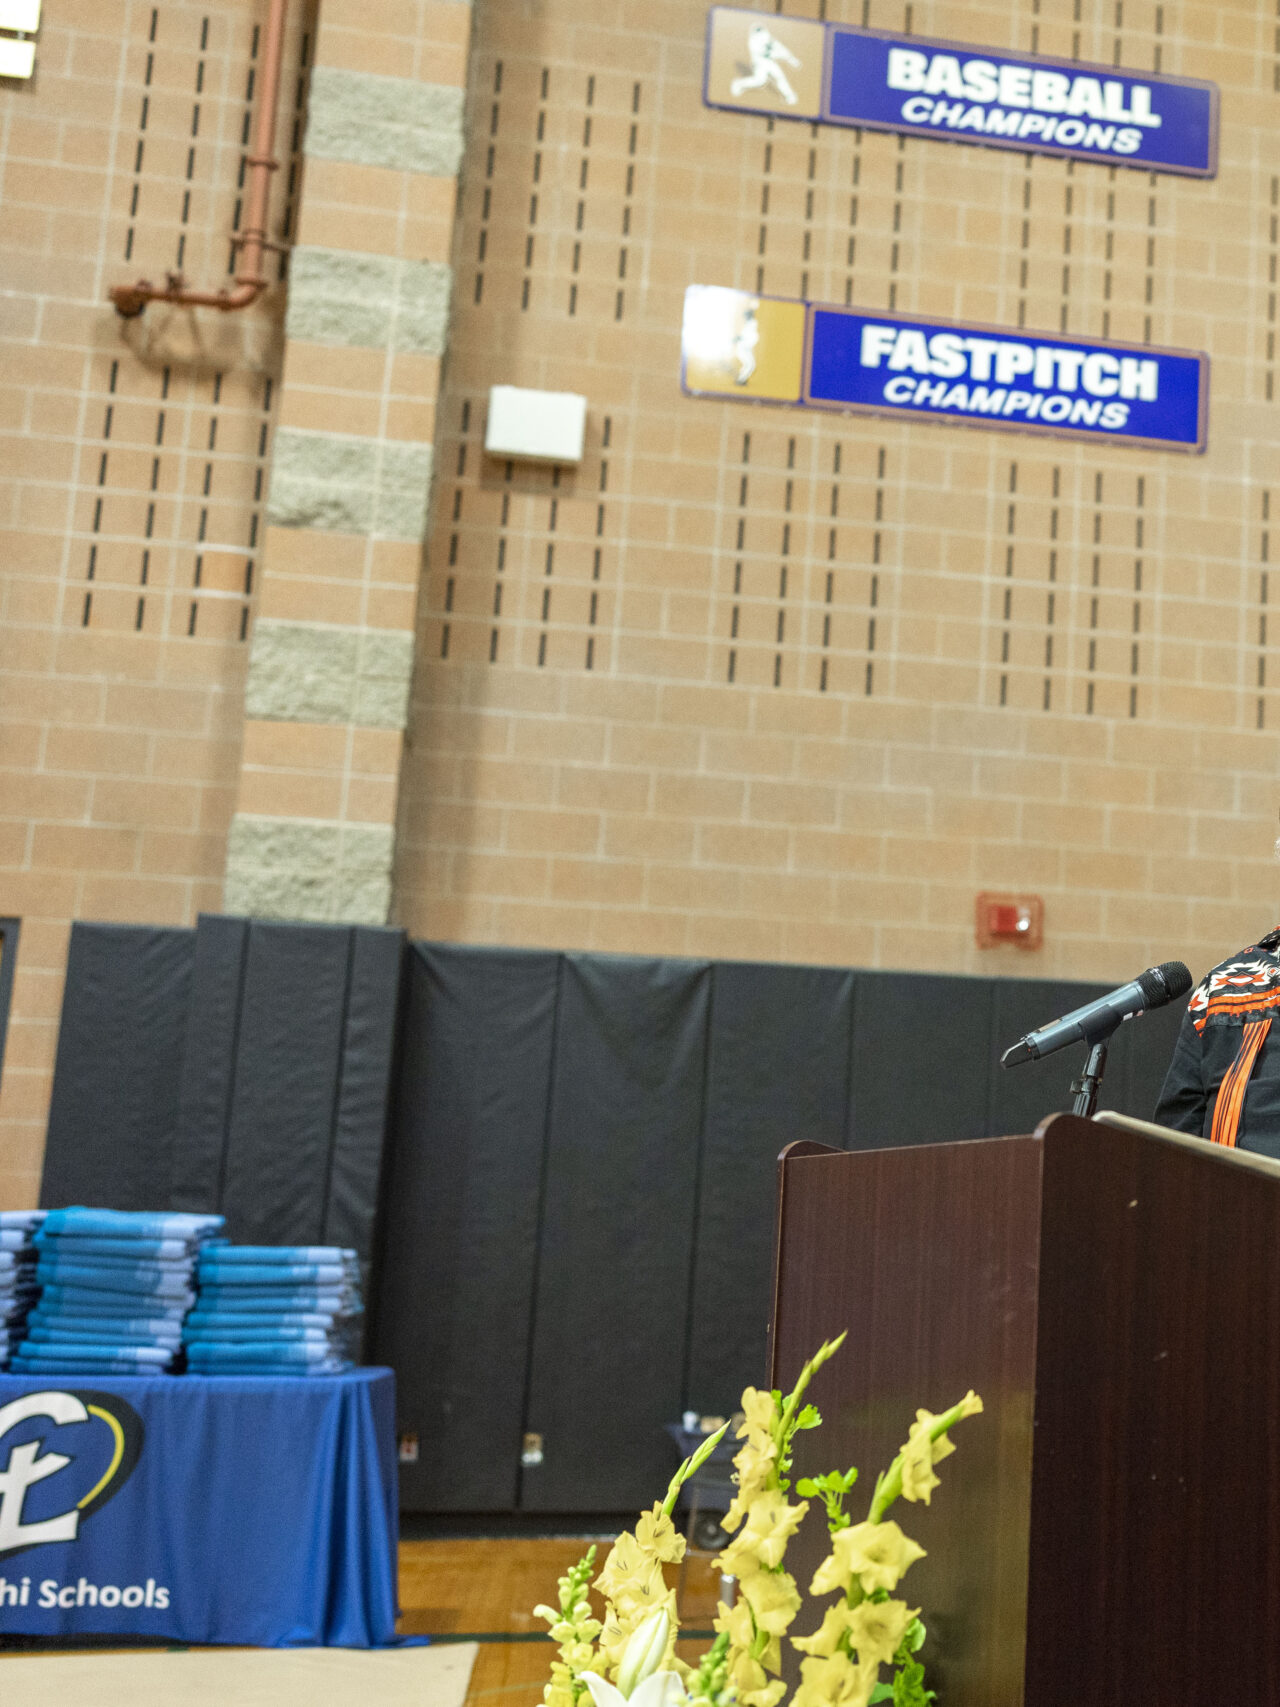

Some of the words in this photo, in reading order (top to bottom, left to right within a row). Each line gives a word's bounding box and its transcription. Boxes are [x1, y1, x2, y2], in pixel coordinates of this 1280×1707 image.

[887, 48, 1162, 128] BASEBALL
[901, 96, 1143, 154] CHAMPIONS
[861, 325, 1158, 401] FASTPITCH
[883, 376, 1130, 429] CHAMPIONS
[38, 1578, 170, 1608] Schools
